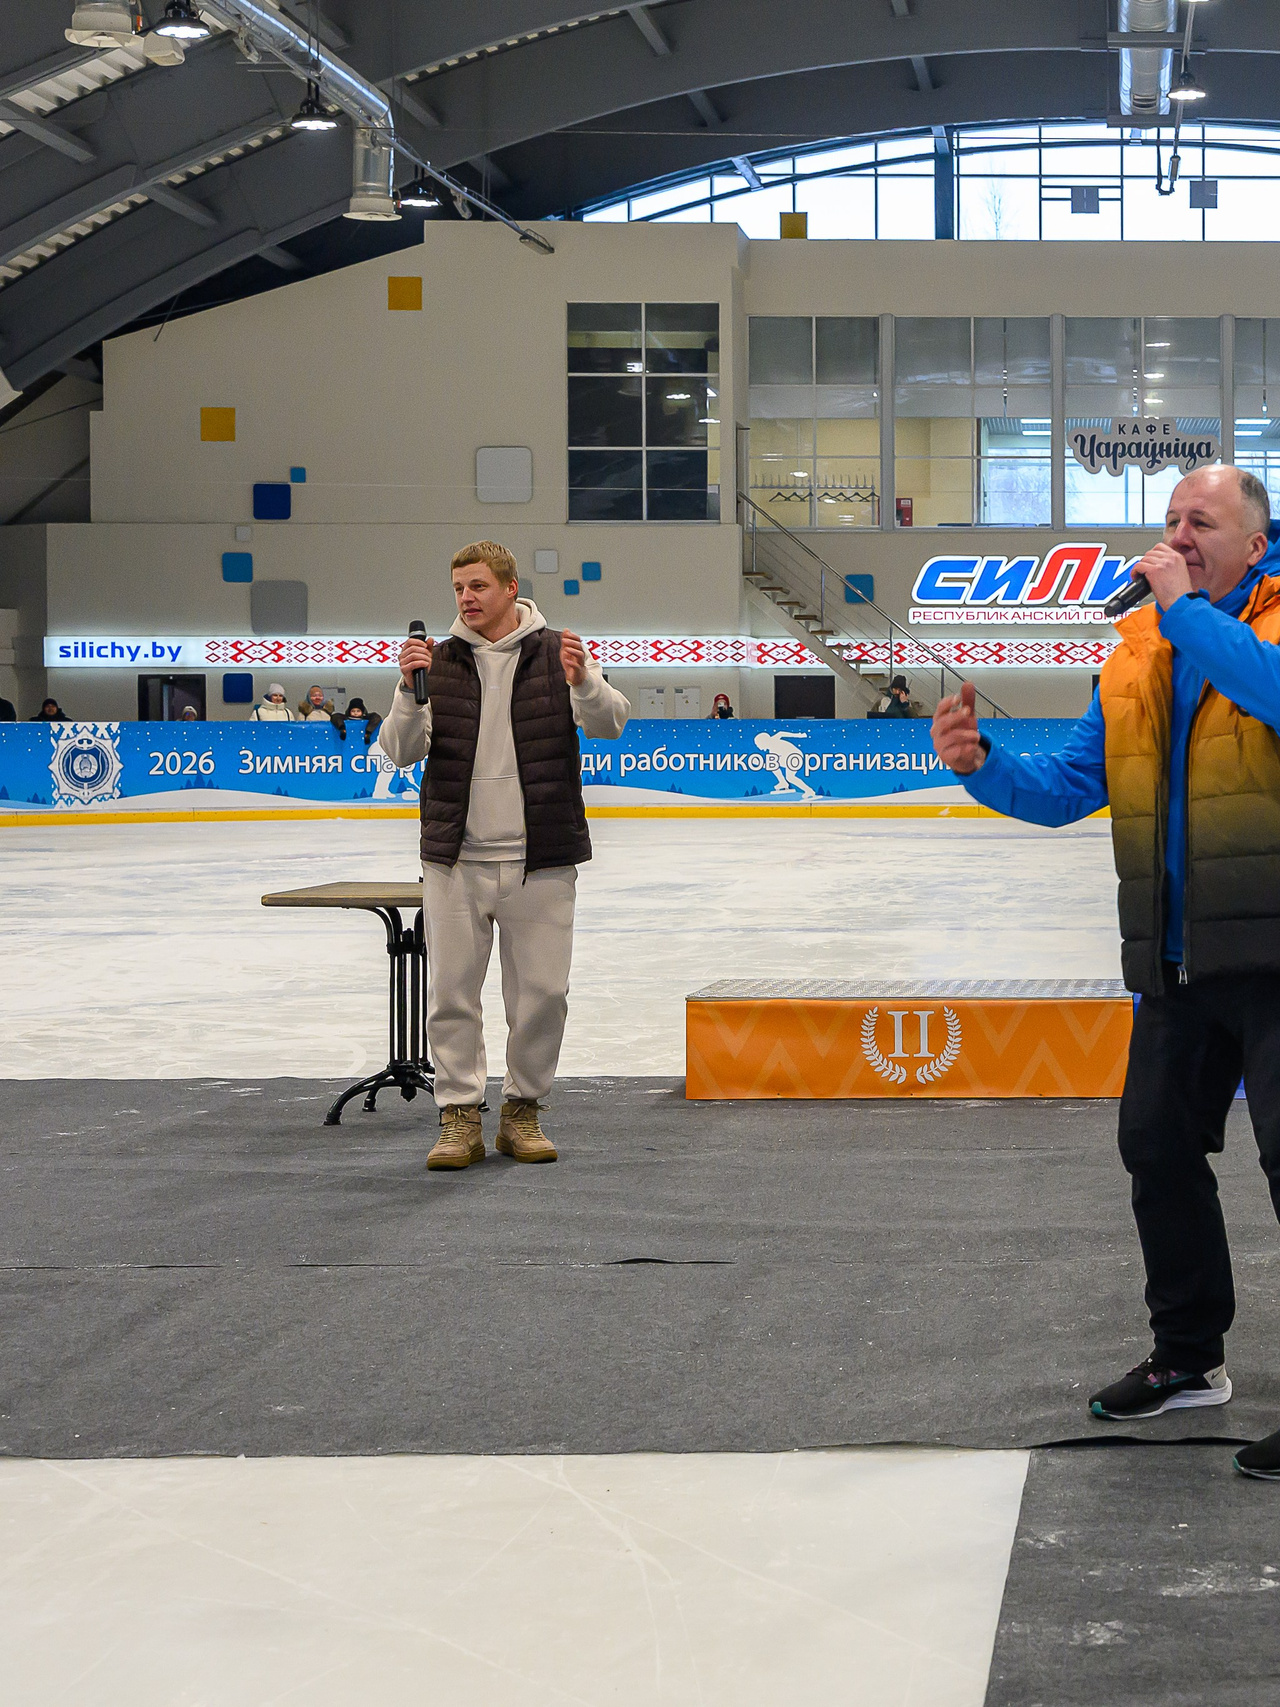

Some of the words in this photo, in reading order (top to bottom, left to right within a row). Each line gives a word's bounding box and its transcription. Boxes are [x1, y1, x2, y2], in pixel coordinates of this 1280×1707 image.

[1118, 423, 1171, 435] КАФЕ
[1073, 433, 1215, 471] Чараўніца
[912, 608, 1080, 621] РЕСПУБЛИКАНСКИЙ
[59, 641, 183, 662] silichy.by
[149, 750, 216, 775] 2026
[238, 750, 343, 775] Зимняя
[620, 746, 780, 777] работников
[786, 753, 951, 775] организаци
[887, 1010, 935, 1058] II
